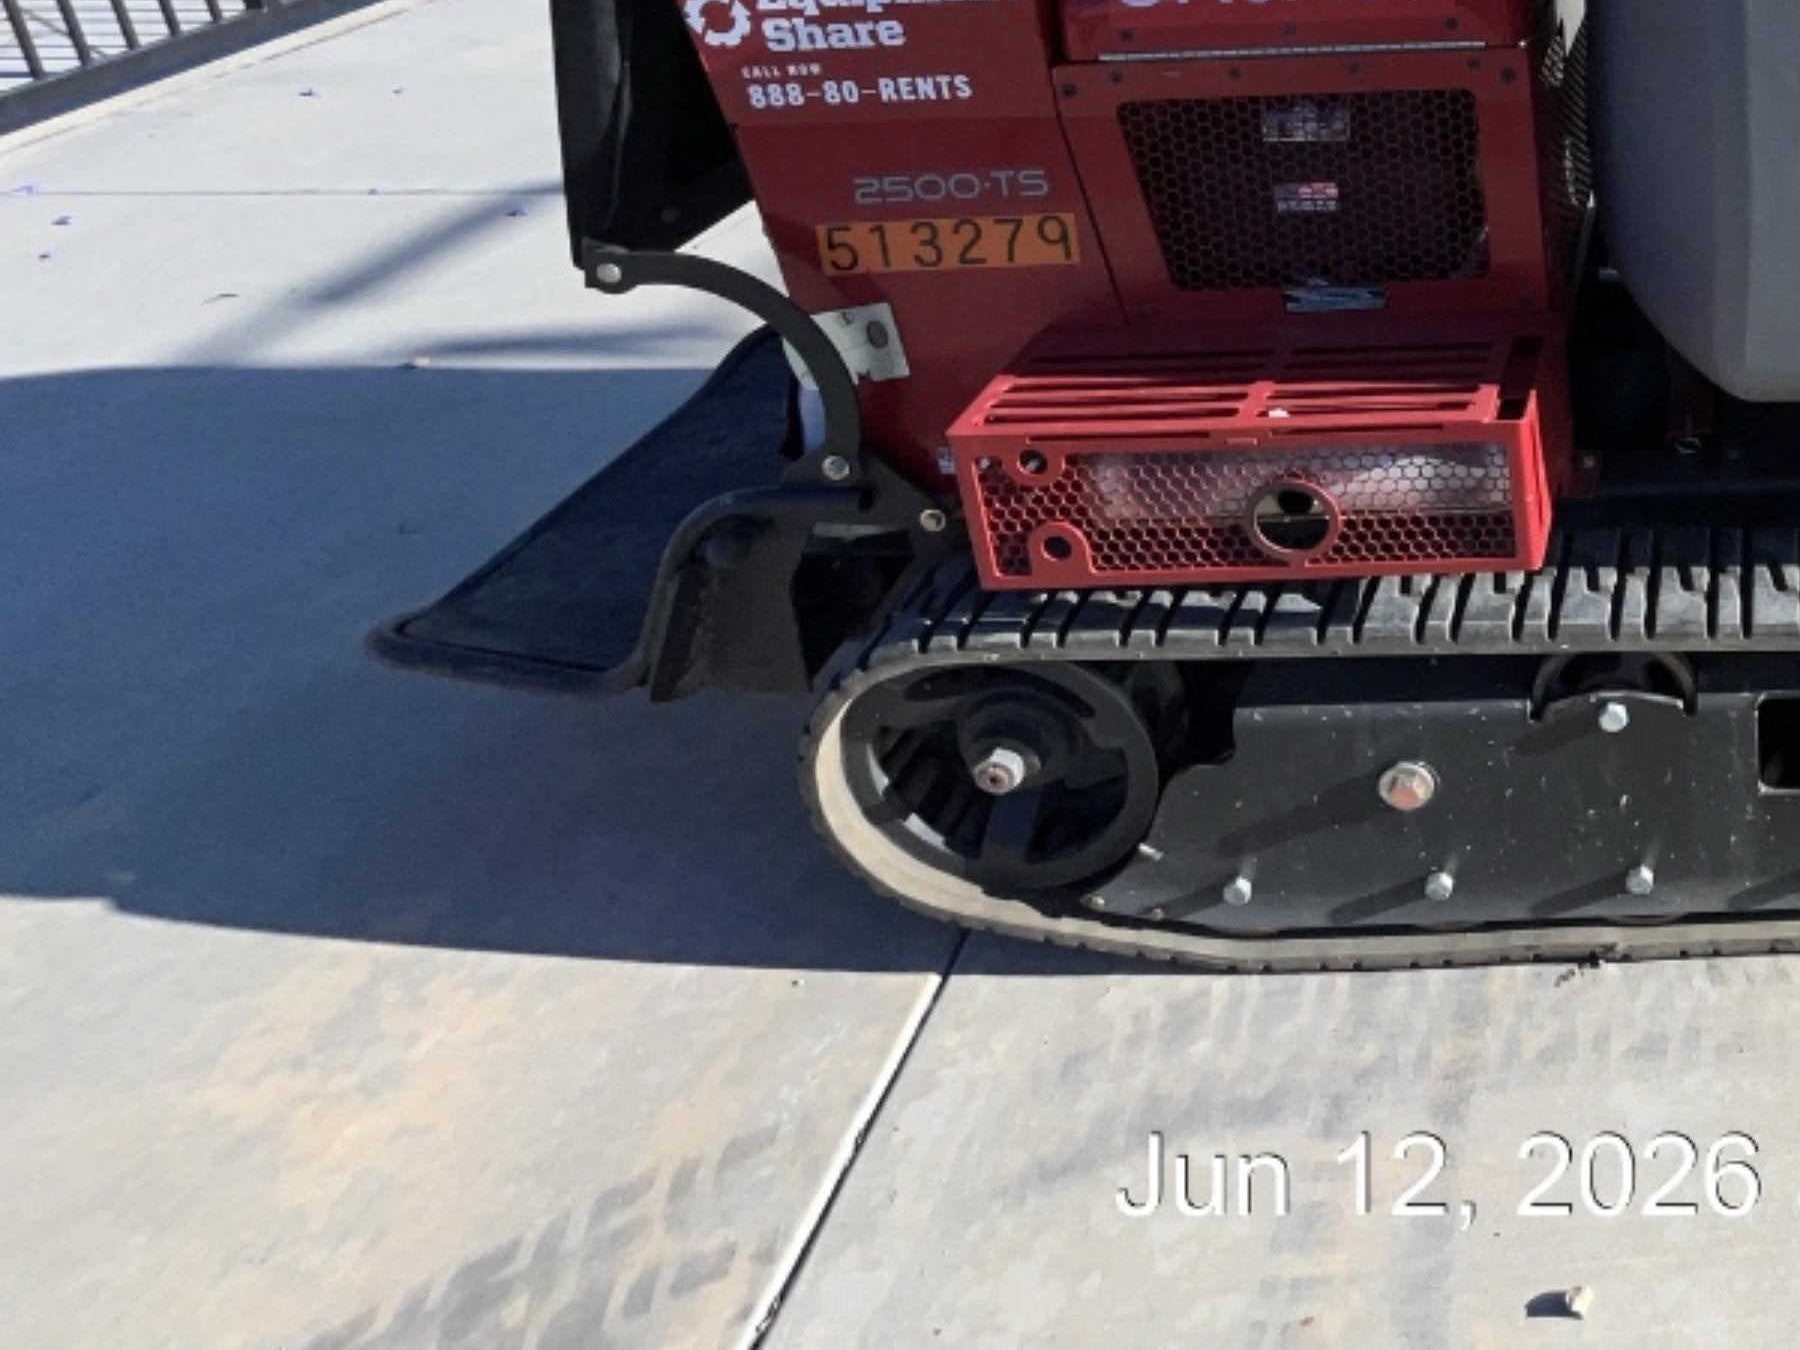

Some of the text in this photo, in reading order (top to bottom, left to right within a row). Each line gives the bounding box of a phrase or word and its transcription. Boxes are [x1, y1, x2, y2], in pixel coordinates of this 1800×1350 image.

[761, 17, 905, 52] Share
[747, 74, 973, 108] 888-80-RENTS
[826, 215, 1073, 271] 513279
